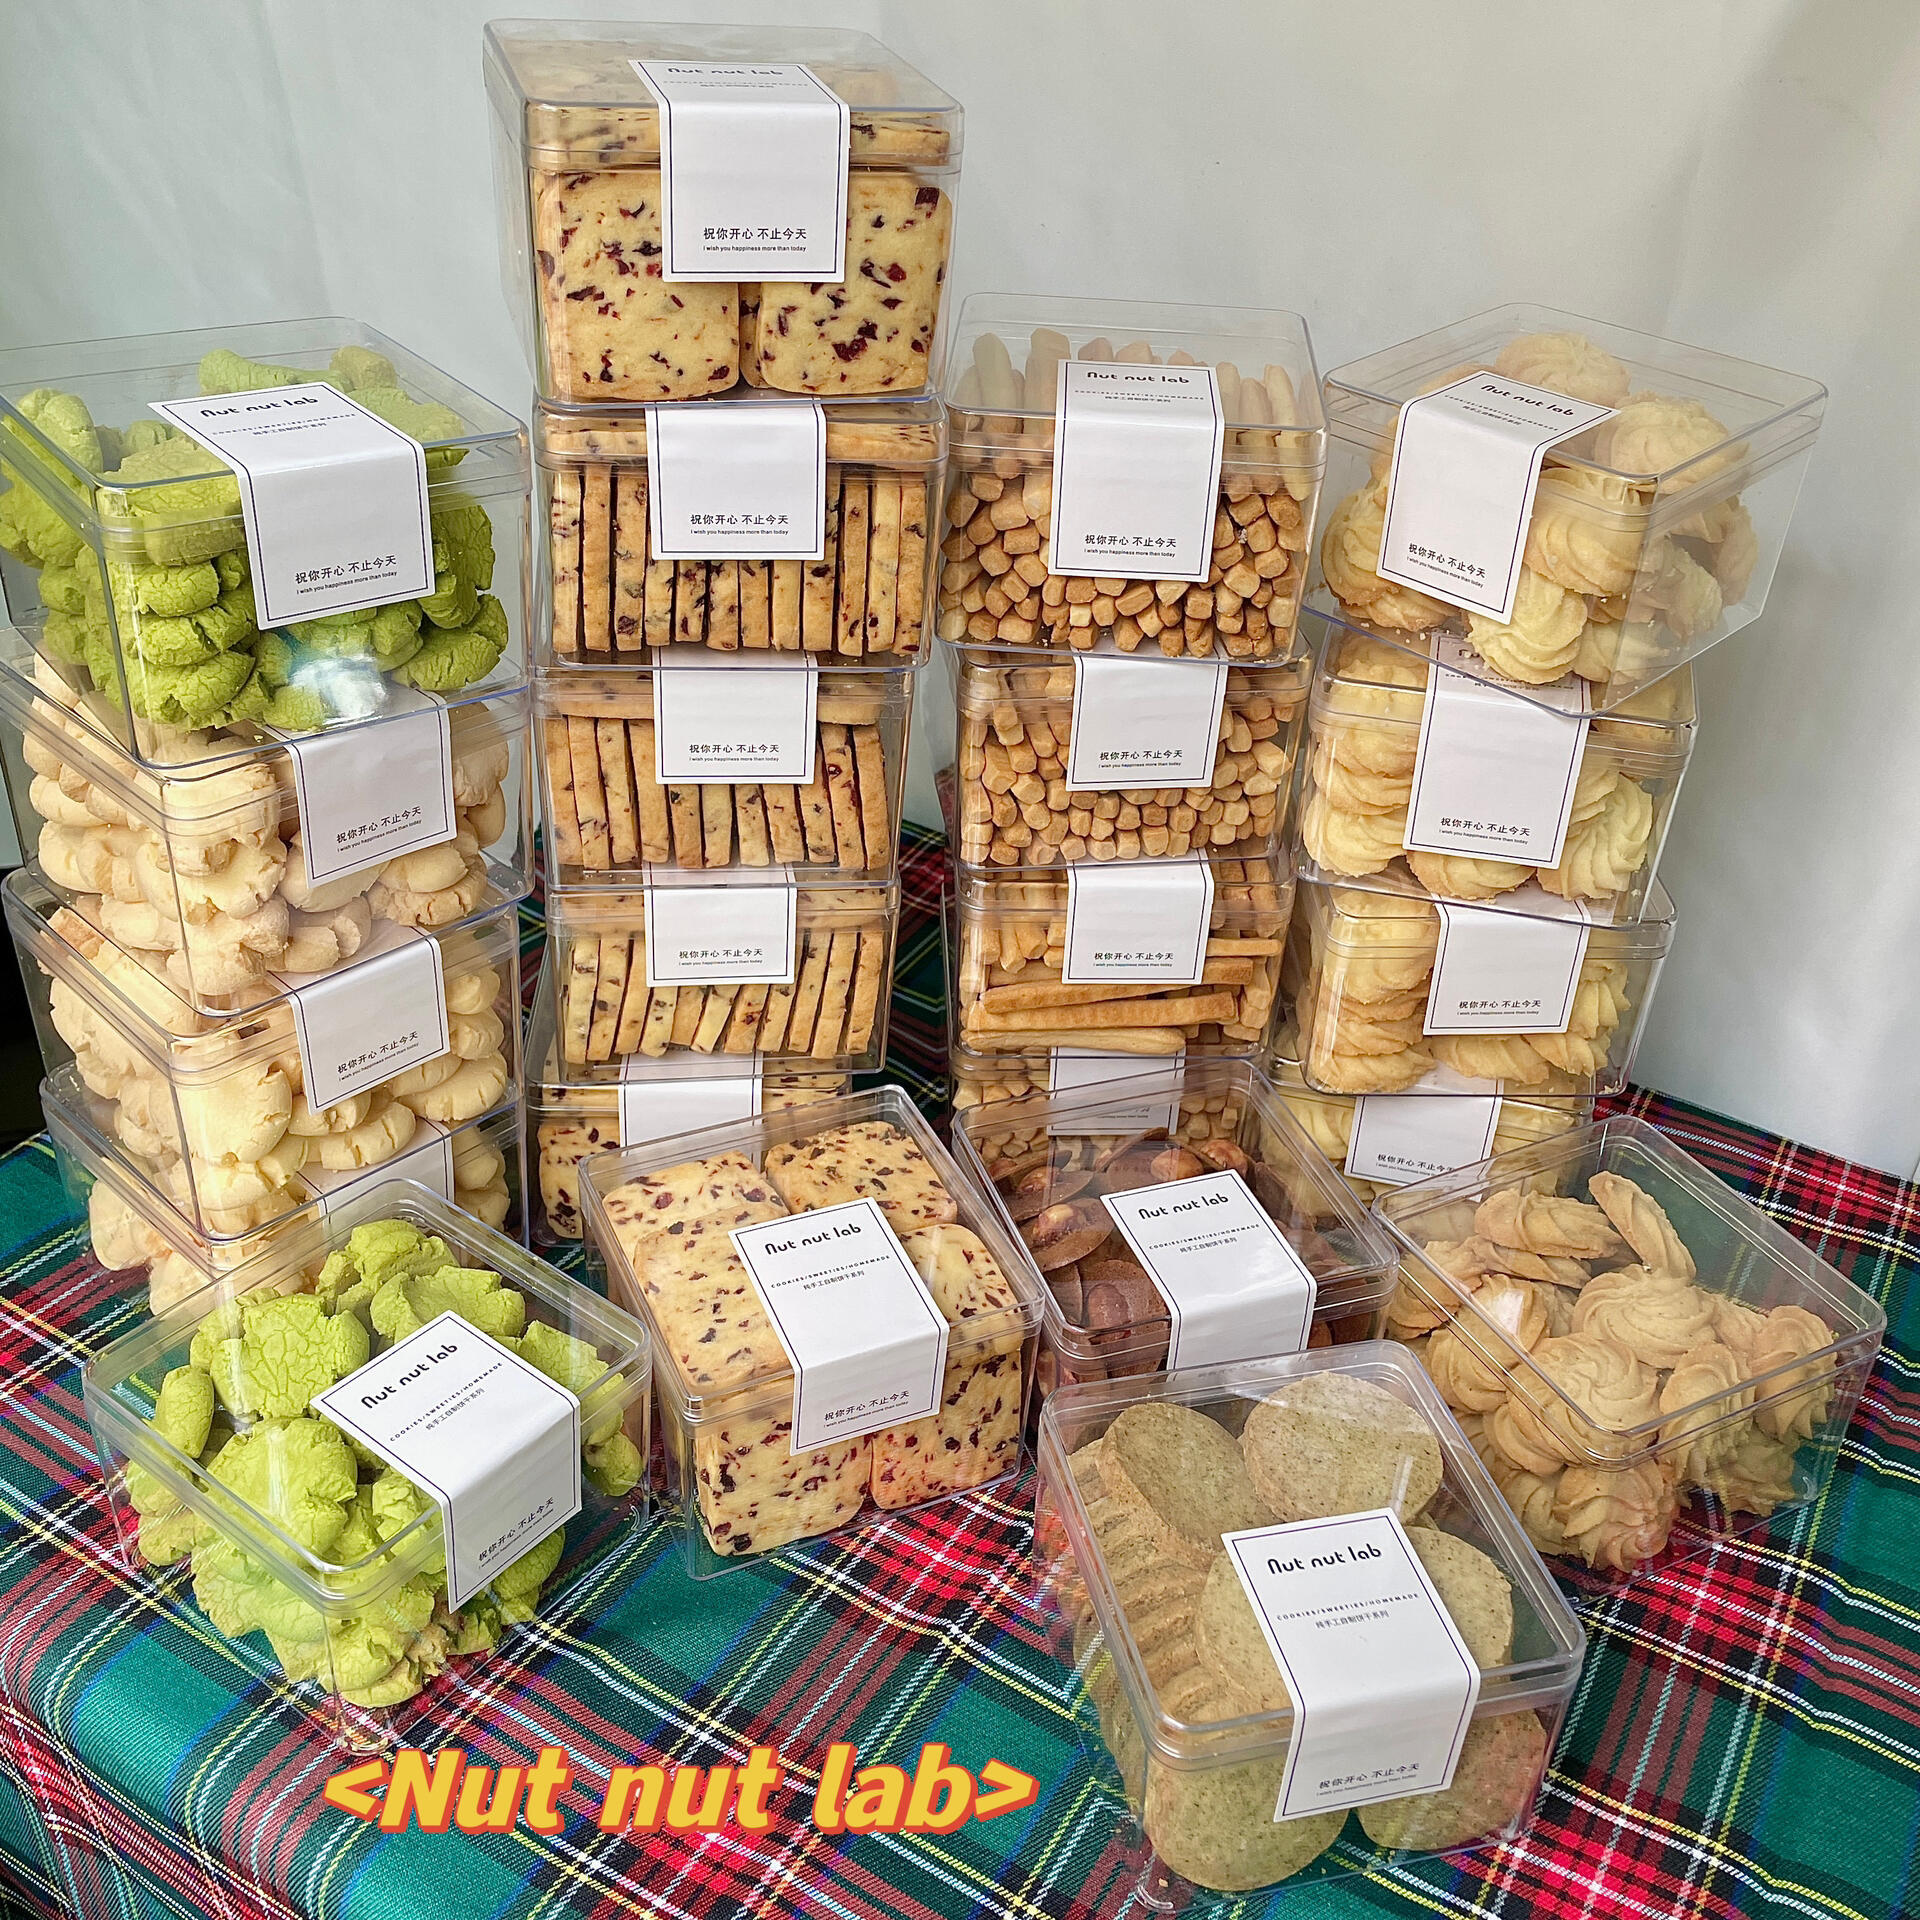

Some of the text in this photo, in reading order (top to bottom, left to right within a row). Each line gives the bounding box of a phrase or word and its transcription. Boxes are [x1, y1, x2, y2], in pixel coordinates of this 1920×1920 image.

[704, 228, 806, 240] 祝你开心 不止今天
[1162, 376, 1189, 384] lab
[246, 402, 282, 412] nut
[283, 397, 318, 406] lab
[1513, 396, 1544, 407] nut
[1546, 404, 1574, 416] lab
[690, 514, 788, 525] 祝你开心 不止今天
[1085, 534, 1176, 548] 祝你开心 不止今天
[1409, 543, 1485, 578] 祝你开心 不止今天
[295, 555, 396, 584] 祝你开心 不止今天
[324, 580, 354, 589] happiness
[689, 744, 779, 753] 祝你开心 不止今天
[1100, 750, 1182, 761] 祝你开心 不止今天
[337, 806, 421, 843] 祝你开心 不止今天
[1441, 818, 1530, 836] 祝你开心 不止今天
[679, 948, 763, 959] 祝你开心 不止今天
[1094, 952, 1173, 960] 祝你开心 不止今天
[1459, 1000, 1541, 1009] 祝你开心 不止今天
[338, 1031, 418, 1073] 祝你开心 不止今天
[1173, 1200, 1200, 1213] nut
[1201, 1193, 1229, 1206] lab
[801, 1232, 831, 1246] nut
[833, 1224, 861, 1238] lab
[399, 1364, 430, 1386] nut
[426, 1345, 458, 1364] lab
[824, 1404, 866, 1421] 祝你开心
[869, 1391, 909, 1407] 不止今天
[1311, 1552, 1346, 1568] nut
[1347, 1543, 1381, 1561] lab
